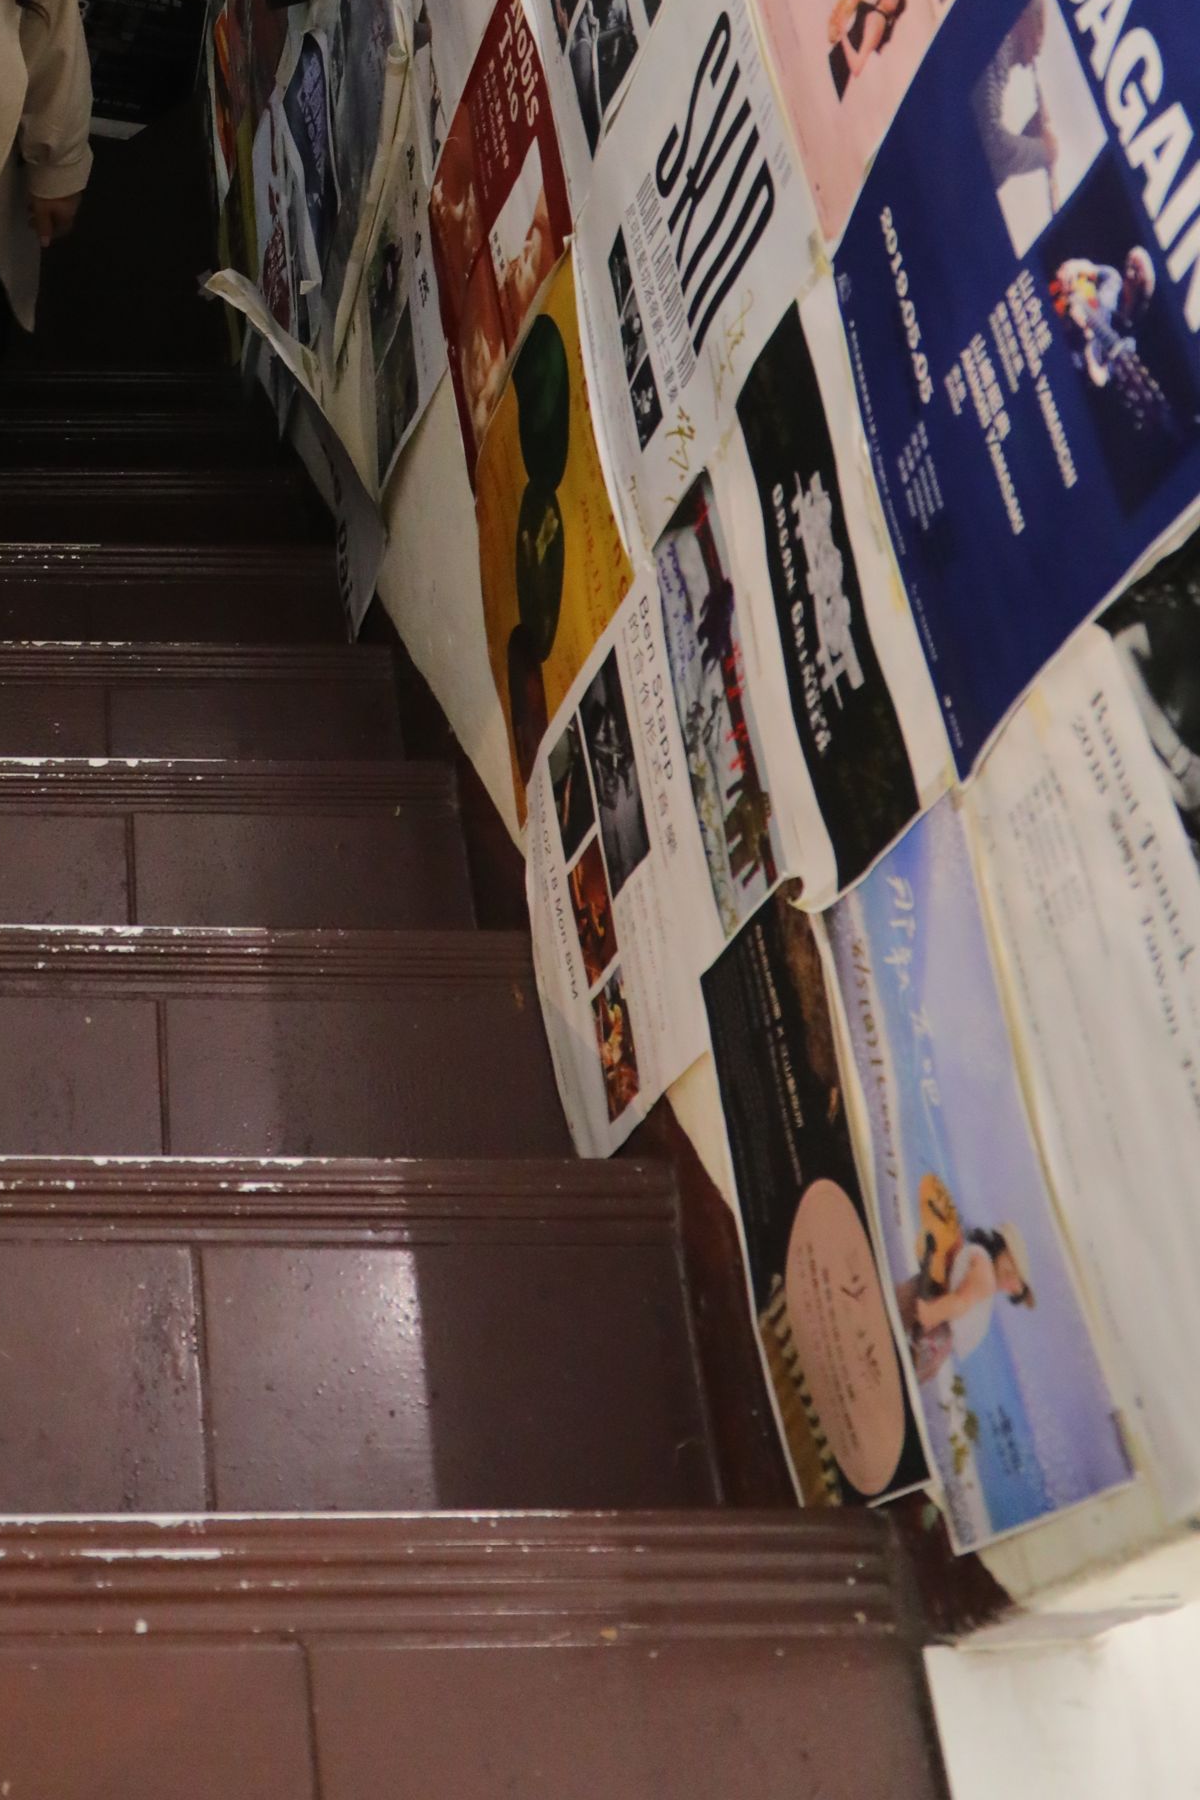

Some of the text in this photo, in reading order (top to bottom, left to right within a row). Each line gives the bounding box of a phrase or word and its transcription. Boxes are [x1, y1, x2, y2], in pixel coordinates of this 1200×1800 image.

[498, 12, 519, 123] Trio
[879, 202, 934, 409] 2019.05.05
[638, 589, 674, 785] Ben Stapp
